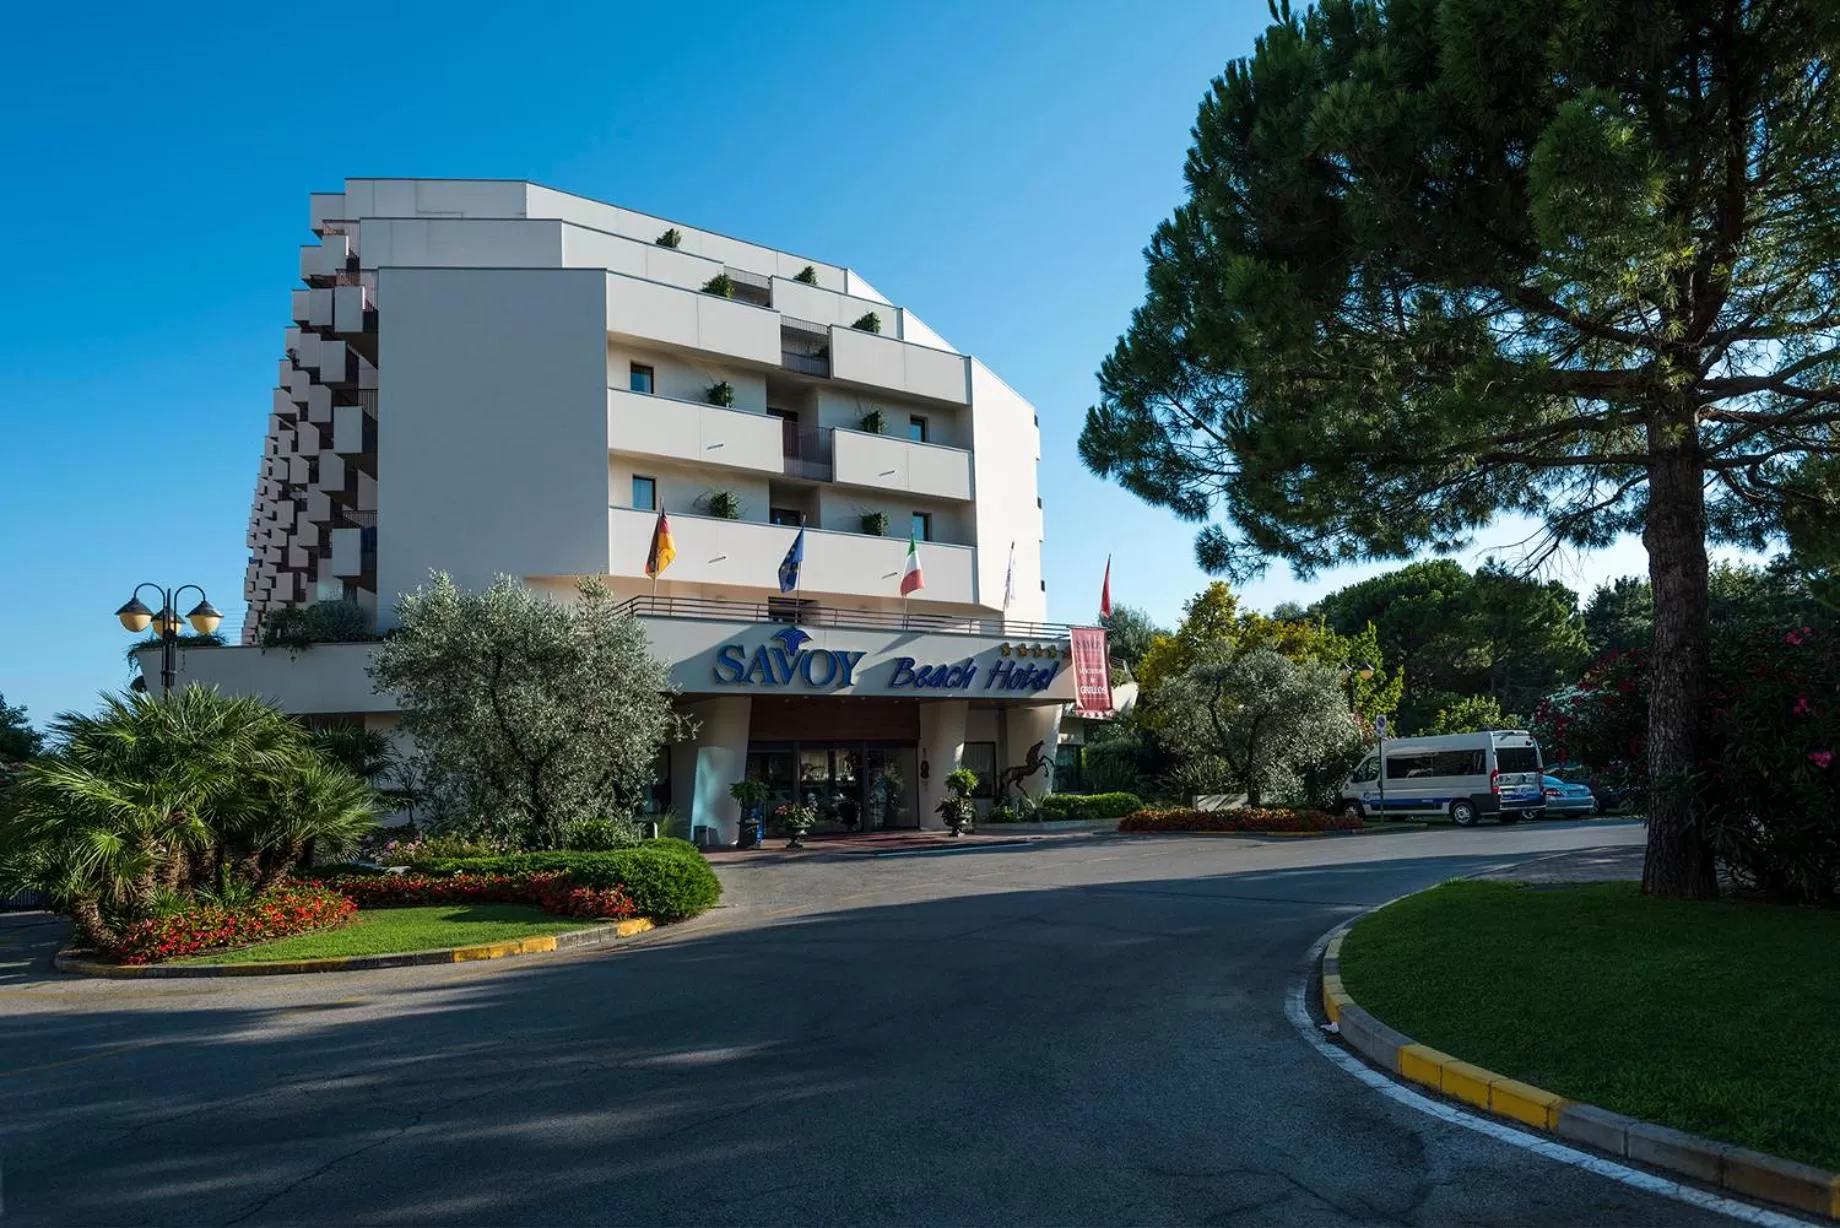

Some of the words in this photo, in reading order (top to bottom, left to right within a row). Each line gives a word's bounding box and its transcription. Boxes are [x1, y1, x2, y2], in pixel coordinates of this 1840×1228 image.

[714, 643, 867, 687] SAVOY
[889, 657, 976, 689] Beach
[985, 660, 1060, 690] Hotel
